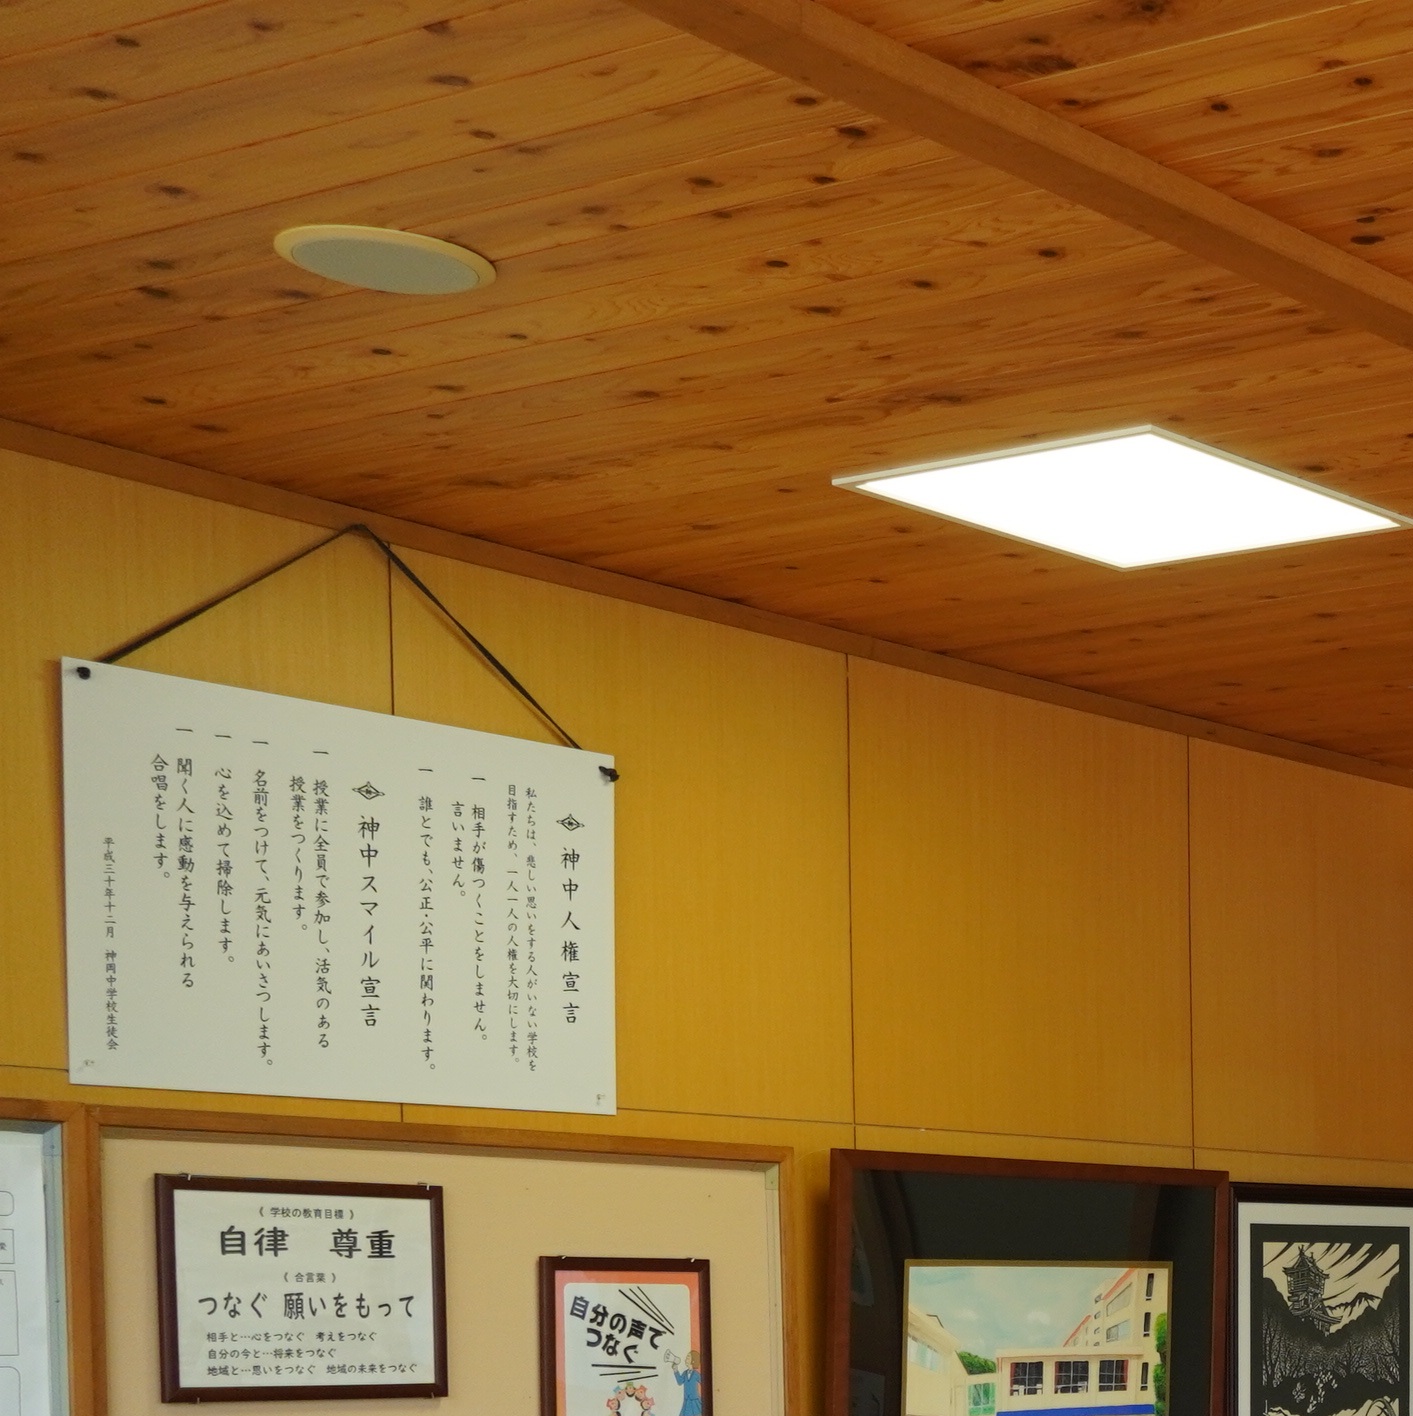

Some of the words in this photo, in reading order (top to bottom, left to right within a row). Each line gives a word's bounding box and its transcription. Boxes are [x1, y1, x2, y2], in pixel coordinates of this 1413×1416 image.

[151, 754, 171, 879] 合唱をします。
[176, 758, 196, 988] 聞く人に感動を与えられる
[214, 767, 234, 963] 心を込めて掃除します。
[289, 775, 307, 930] 授業をつくります。
[451, 801, 466, 897] 言いません。
[103, 837, 117, 939] 平成三十年十二月
[252, 769, 273, 1066] 名前をつけて、元気にあいさつします。
[312, 779, 332, 1048] 授業に全員で参加し、活気のある
[357, 815, 381, 1027] 神中スマイル宣言
[418, 796, 436, 1070] 誰とでも、公正・公平に関わります。
[471, 804, 487, 1041] 相手が傷つくことをしません。
[506, 784, 520, 1063] 目指すため、一人一人の人権を大切にします。
[525, 787, 538, 1072] 私たちは、悲しい思いをする人がいない学校を
[560, 847, 581, 1024] 神中人権宣言
[105, 949, 119, 1051] 神岡中学校生徒会
[198, 1292, 268, 1318] つなぐ
[283, 1292, 415, 1319] 願いをもって
[220, 1225, 289, 1257] 自律
[329, 1228, 396, 1259] 尊重
[206, 1331, 305, 1342] 相手と…心をつなぐ
[315, 1331, 378, 1342] 考えをつなぐ
[207, 1348, 337, 1359] 自分の今と…将来をつなぐ
[207, 1364, 316, 1376] 地域と…思いをつなぐ
[326, 1362, 418, 1374] 地域の未来をつなぐ
[569, 1296, 667, 1350] 自分の声で
[586, 1327, 639, 1364] つなぐ
